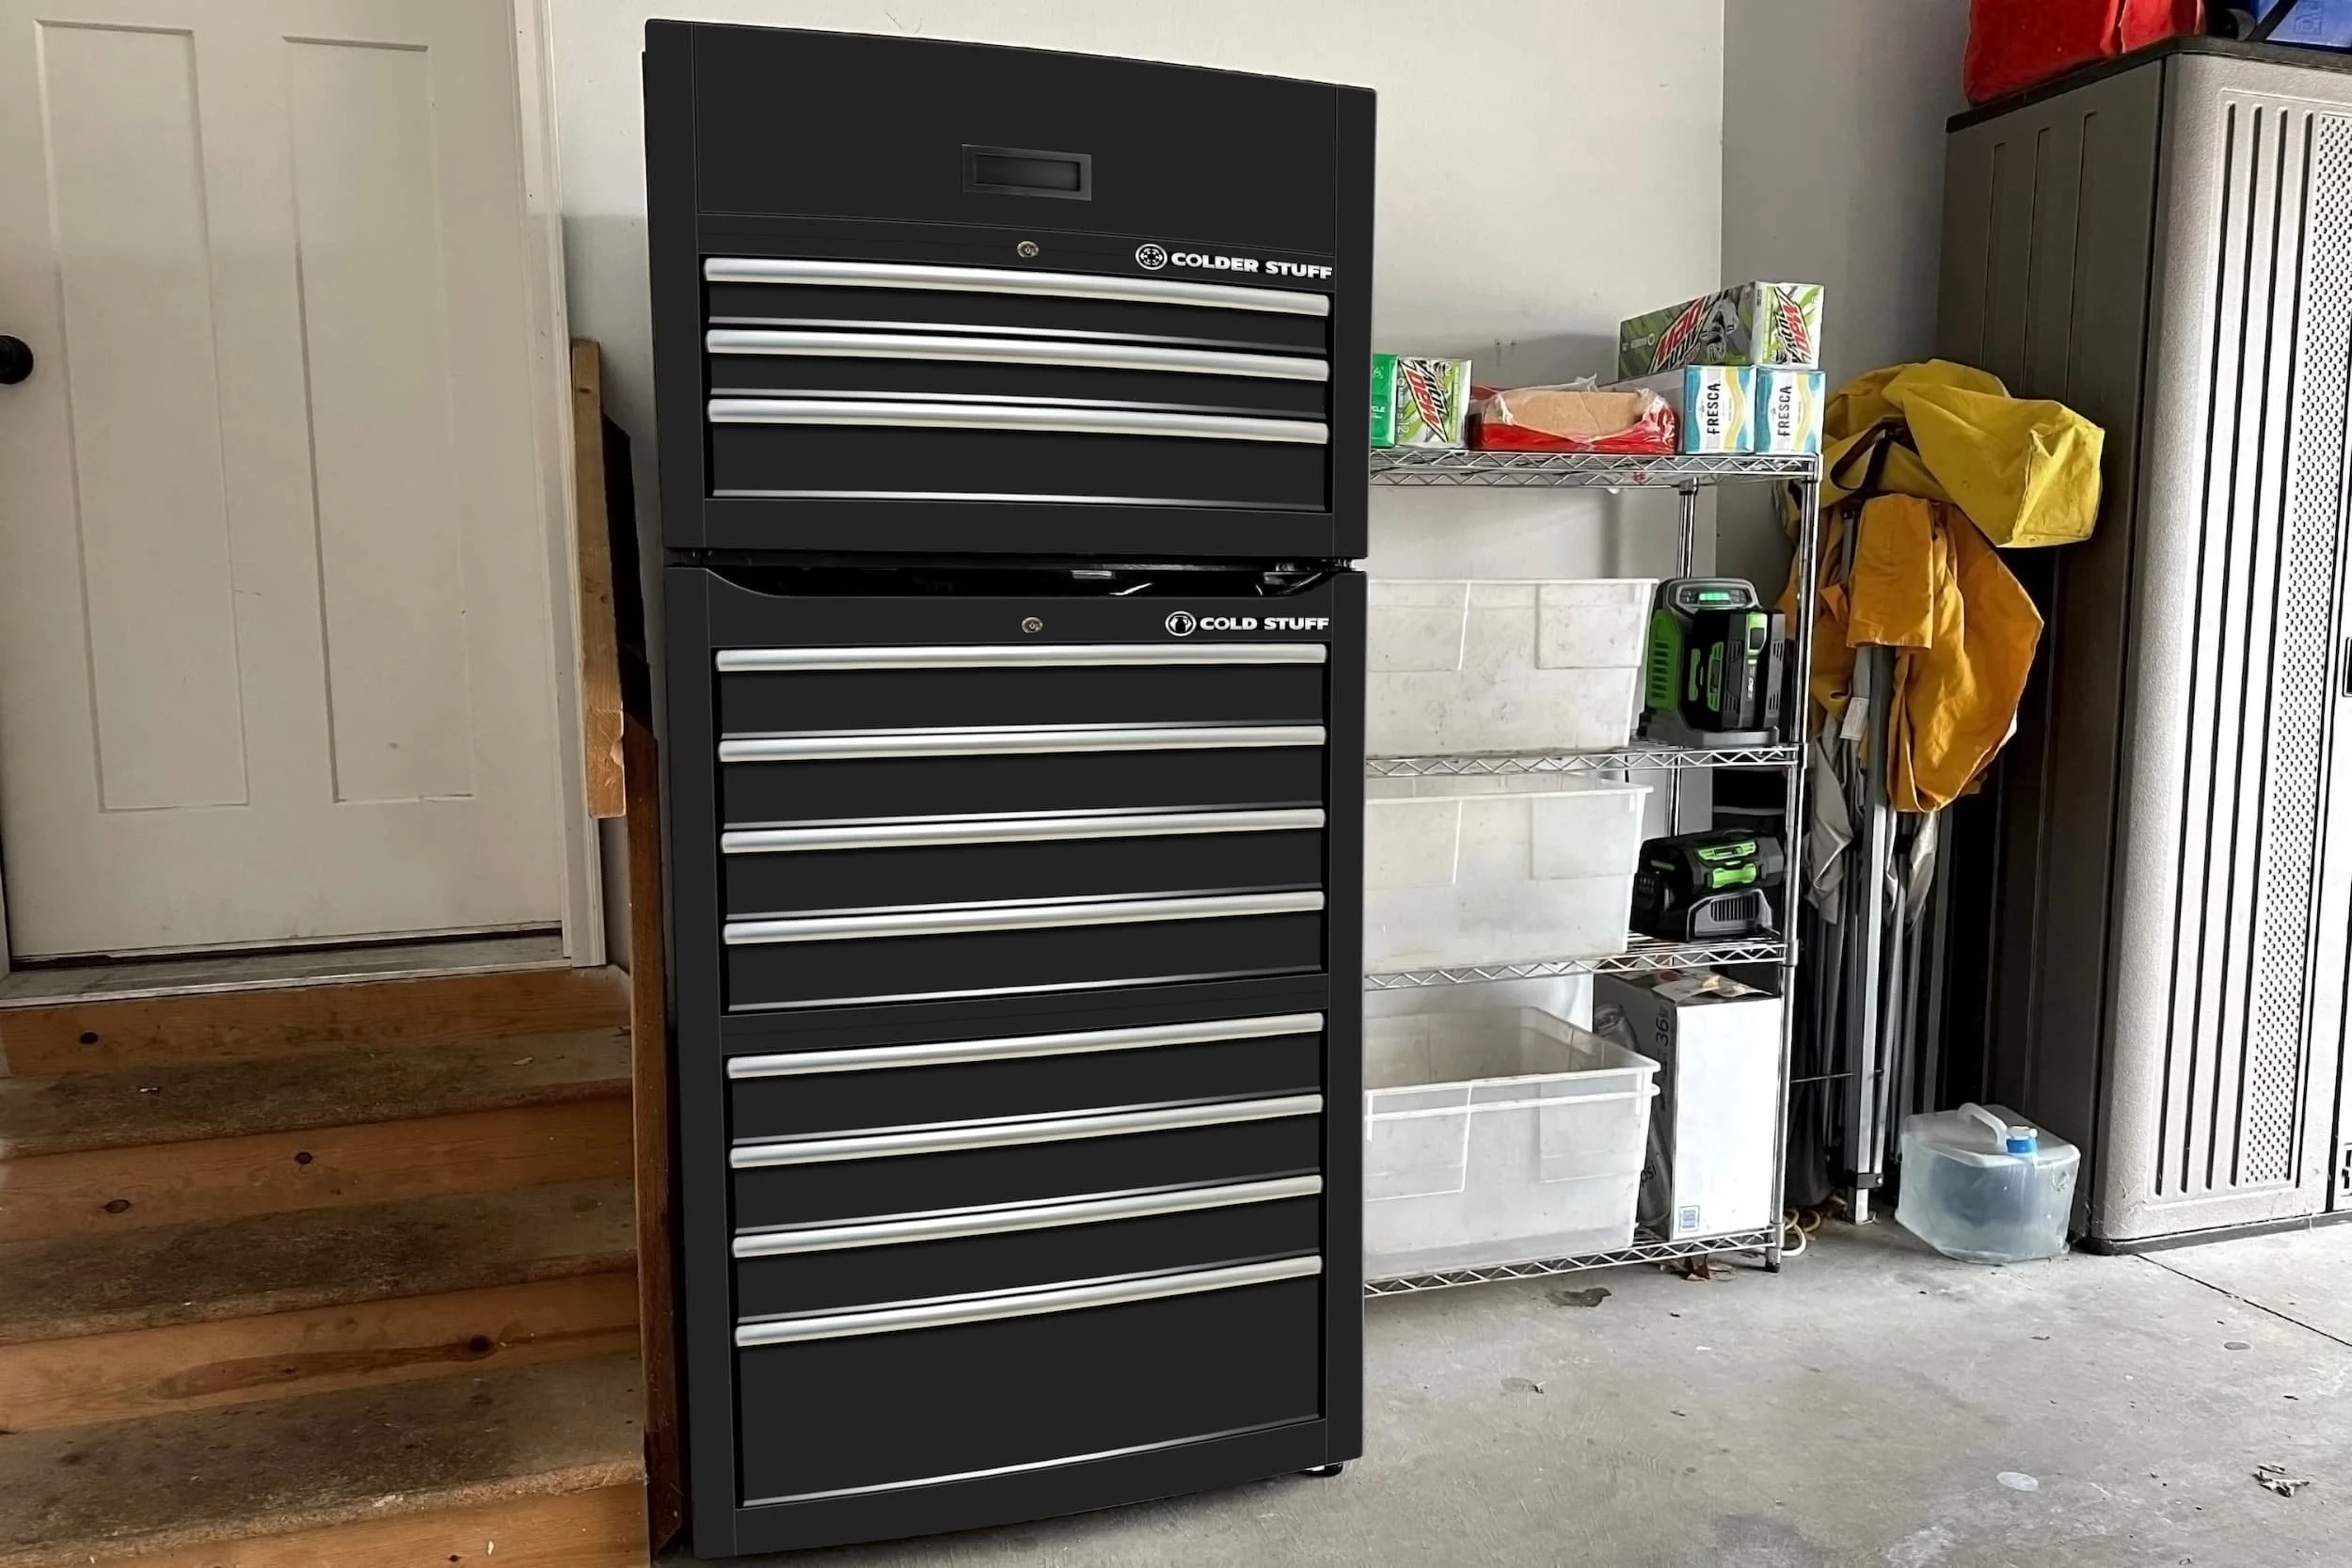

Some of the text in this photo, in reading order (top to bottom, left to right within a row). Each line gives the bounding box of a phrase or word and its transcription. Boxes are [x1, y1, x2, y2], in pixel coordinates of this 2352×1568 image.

[1170, 252, 1333, 279] COLDER STUFF
[1707, 383, 1721, 436] FRESCA
[1777, 385, 1792, 437] FRESCA
[1200, 616, 1330, 630] COLD STUFF
[1656, 1017, 1669, 1047] 36
[1640, 1160, 1656, 1188] psi
